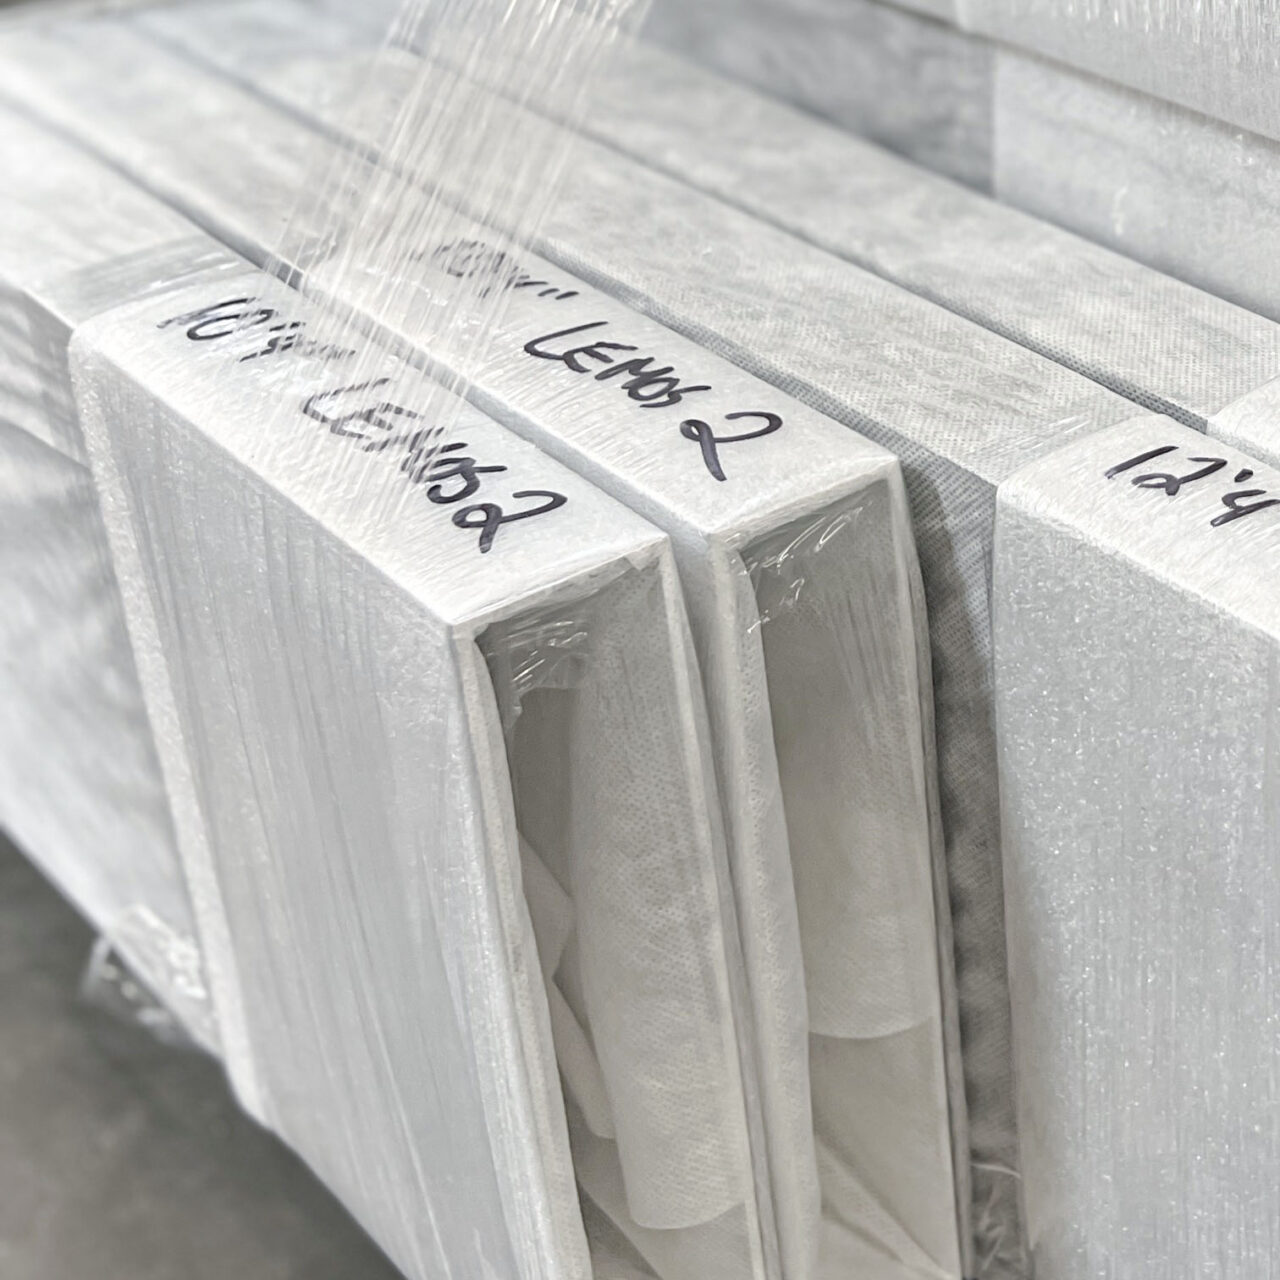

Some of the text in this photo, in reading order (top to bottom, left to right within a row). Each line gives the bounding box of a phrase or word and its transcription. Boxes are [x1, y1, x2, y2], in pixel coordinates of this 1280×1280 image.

[523, 321, 711, 408] LEMOS
[679, 411, 783, 481] 2
[451, 489, 569, 554] 2
